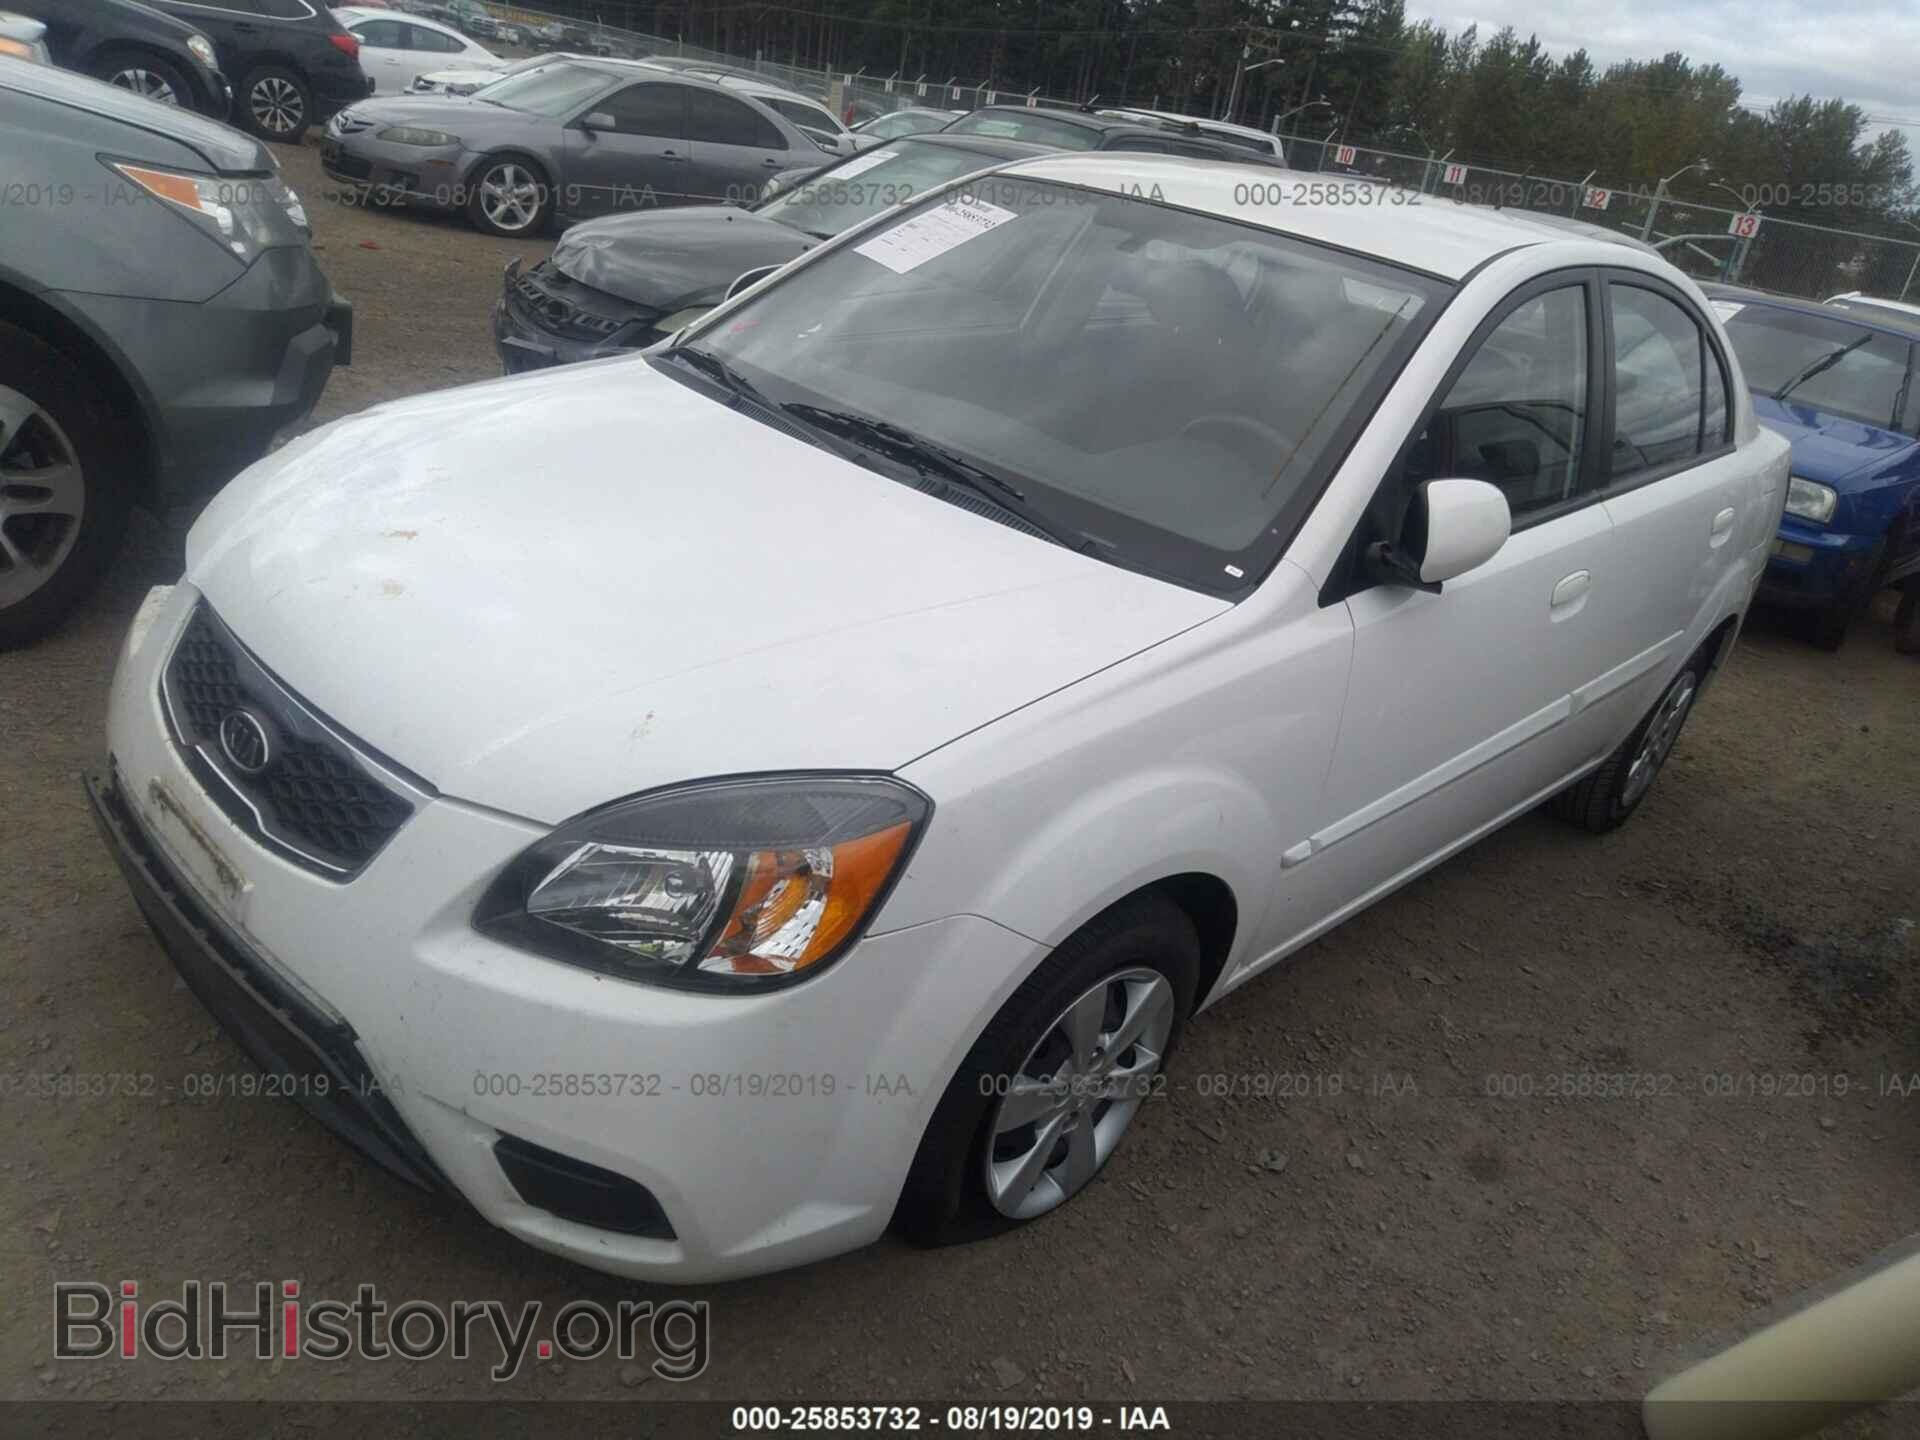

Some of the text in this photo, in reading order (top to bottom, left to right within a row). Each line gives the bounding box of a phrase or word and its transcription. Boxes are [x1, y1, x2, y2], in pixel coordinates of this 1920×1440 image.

[1340, 147, 1354, 164] 10
[1450, 165, 1463, 184] 11
[1590, 189, 1607, 209] 12
[1734, 214, 1756, 236] 13
